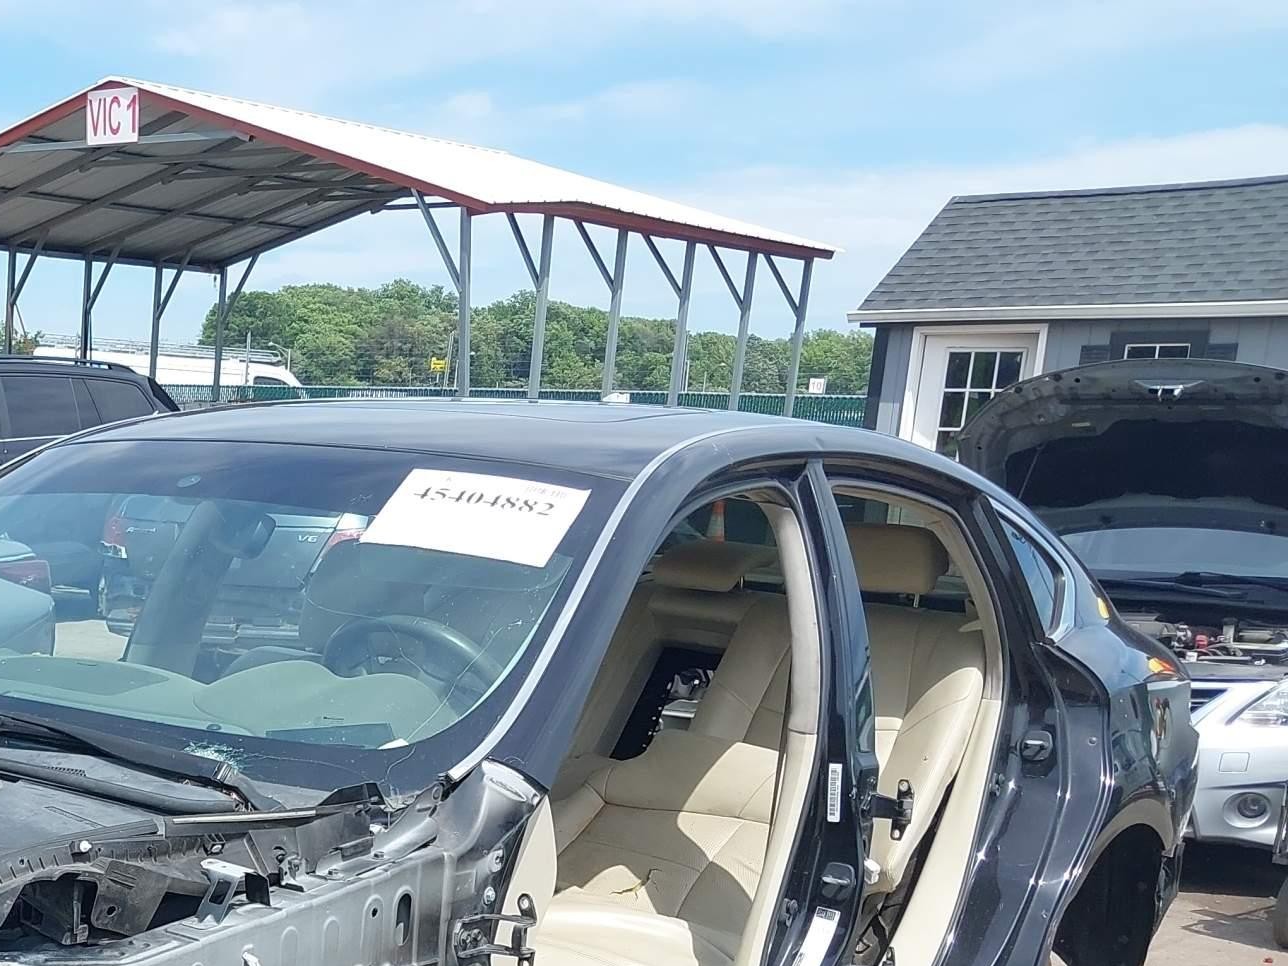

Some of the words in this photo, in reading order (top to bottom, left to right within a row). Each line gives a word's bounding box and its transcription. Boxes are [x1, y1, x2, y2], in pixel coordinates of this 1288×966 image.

[89, 96, 121, 136] VIC
[127, 94, 137, 133] 1
[413, 485, 555, 516] 45404882
[298, 534, 318, 543] V6
